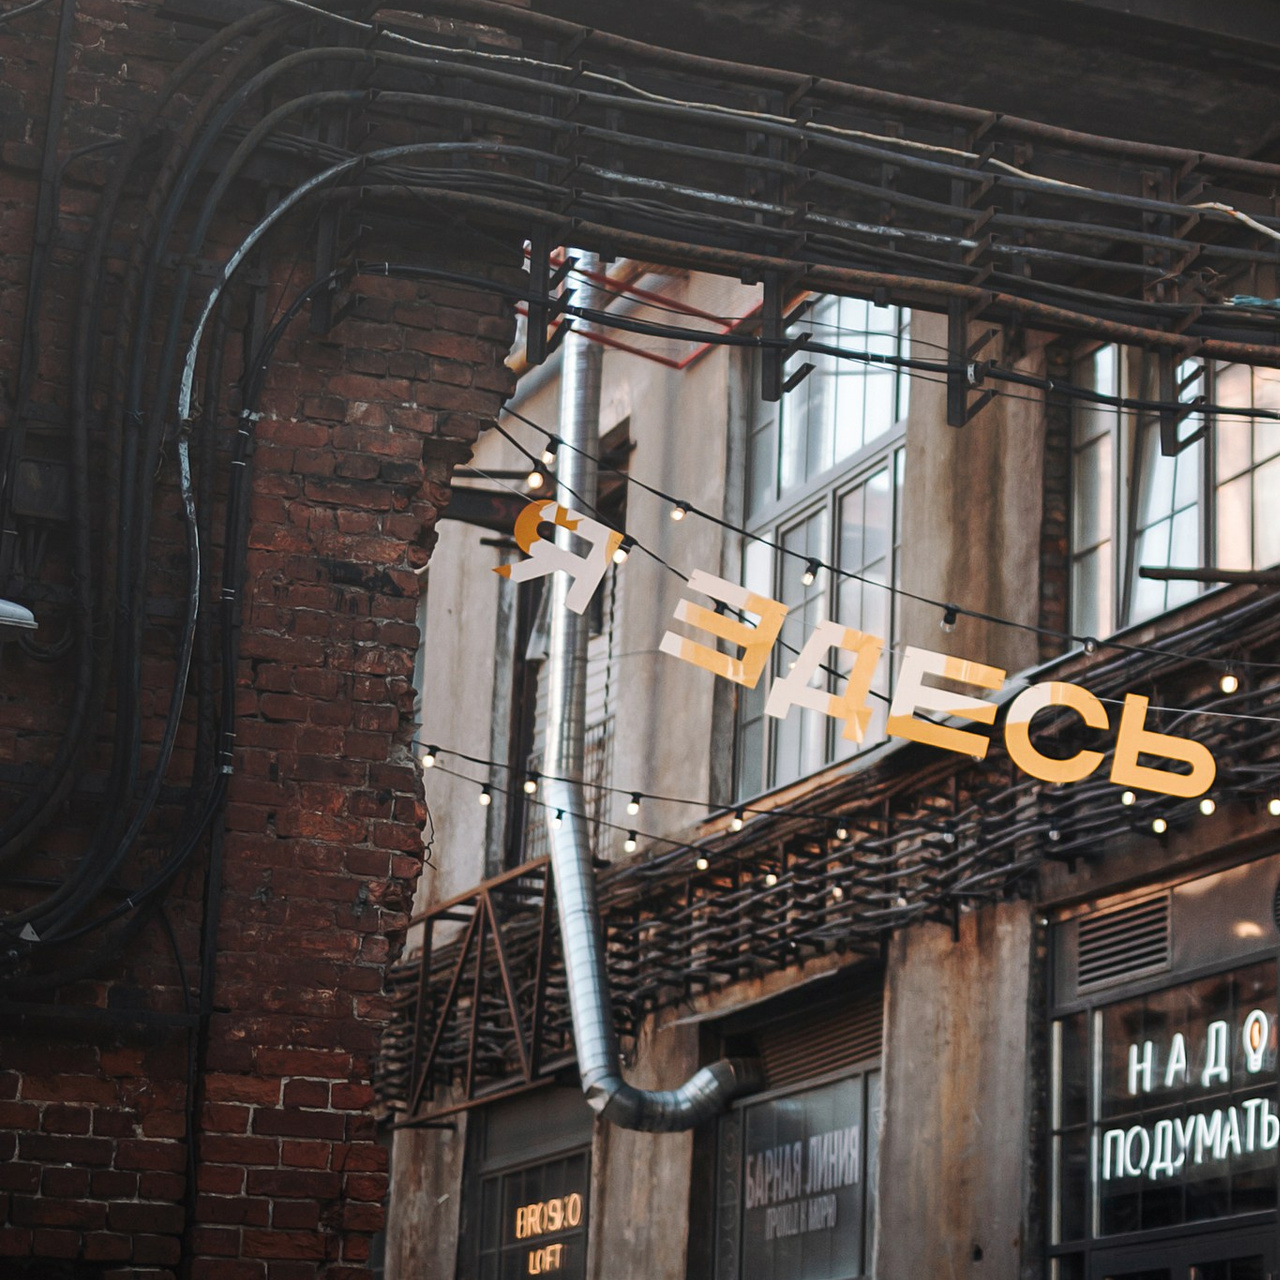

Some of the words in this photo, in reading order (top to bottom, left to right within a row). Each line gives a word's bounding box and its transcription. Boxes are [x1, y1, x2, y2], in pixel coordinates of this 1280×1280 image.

[491, 499, 625, 615] Я
[746, 1141, 802, 1209] БАРНАЯ
[806, 1125, 859, 1194] ЛИНИЯ
[1102, 1098, 1280, 1180] ПОДУМАТЬ
[528, 1243, 563, 1275] LOFT
